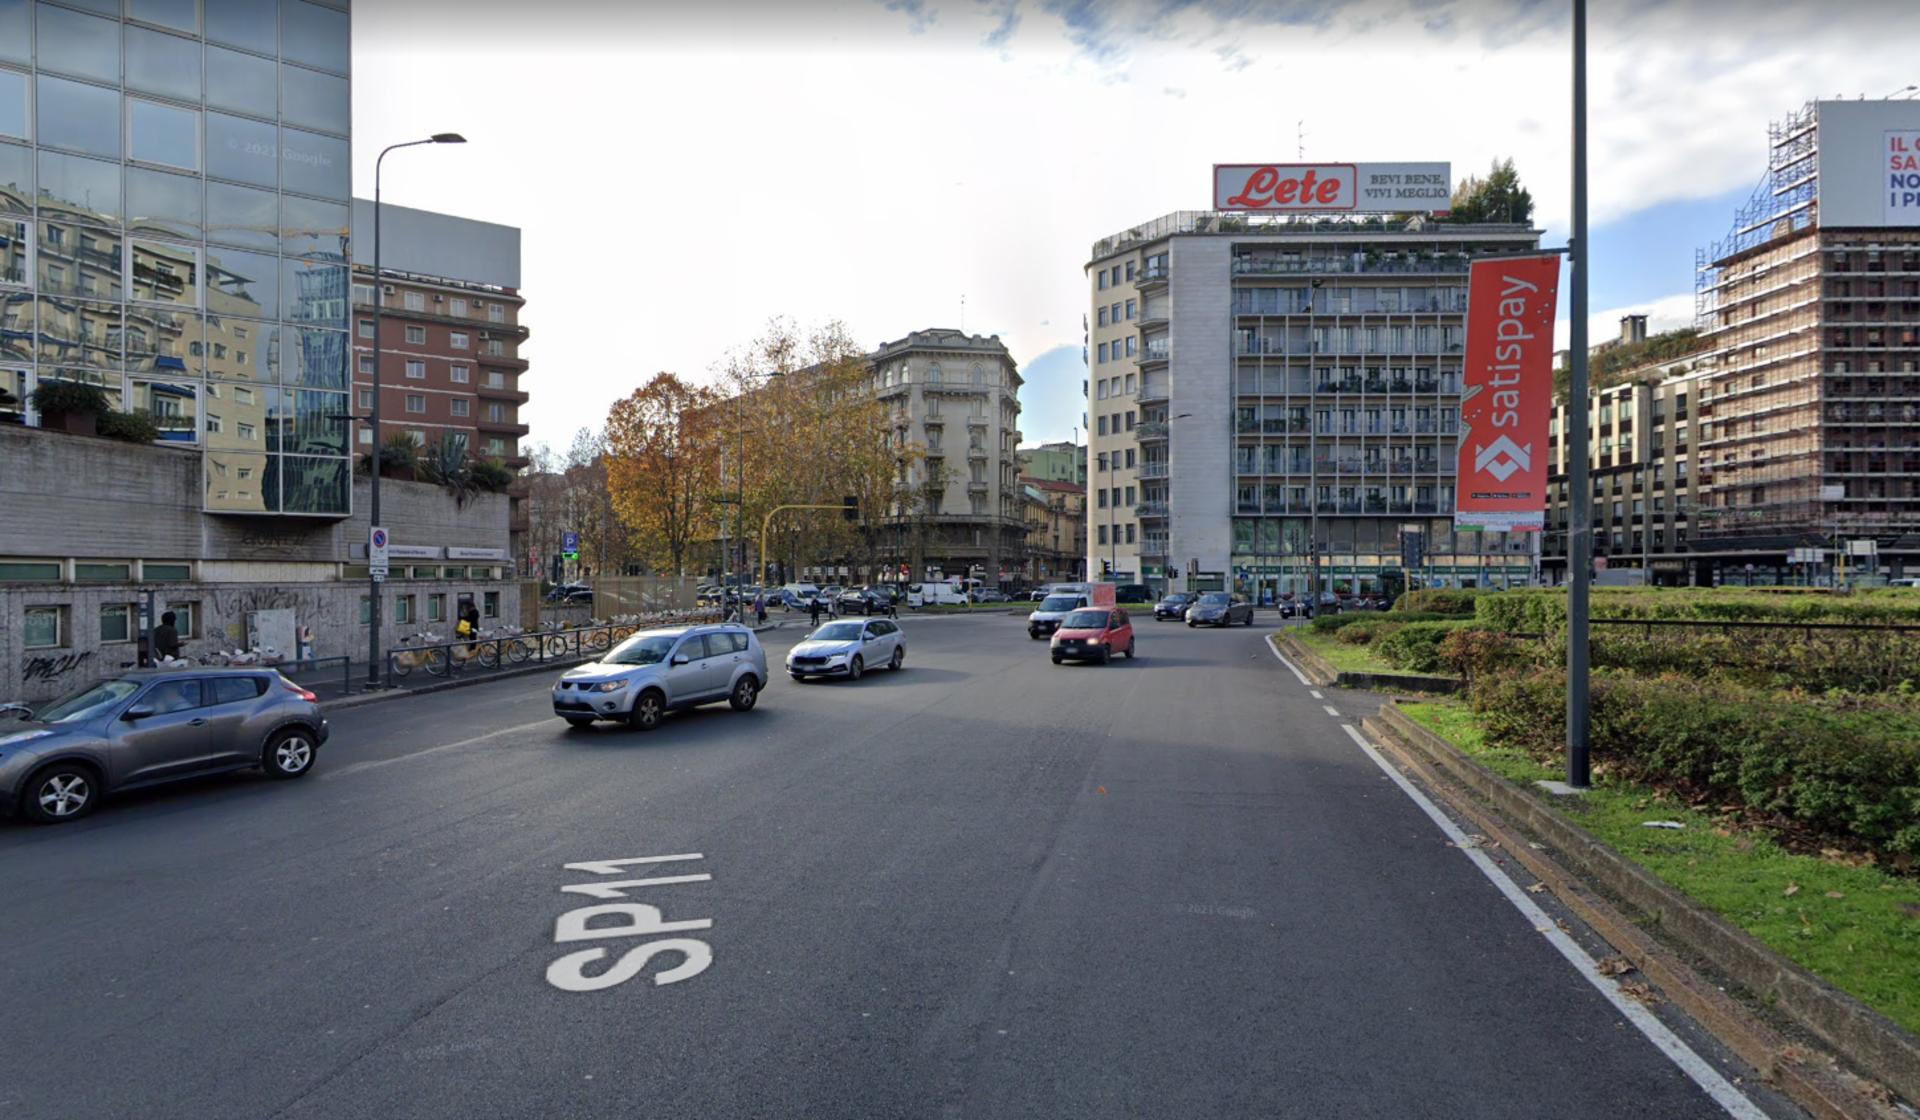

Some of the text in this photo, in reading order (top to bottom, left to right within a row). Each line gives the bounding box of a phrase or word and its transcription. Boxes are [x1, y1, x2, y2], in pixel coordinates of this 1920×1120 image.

[1890, 137, 1909, 152] IL
[1227, 166, 1341, 208] Lete
[1364, 187, 1449, 198] VIVI MEGLIO.
[1370, 174, 1445, 187] BEVI BENE,
[1487, 275, 1538, 428] satispay
[545, 852, 713, 992] SP11
